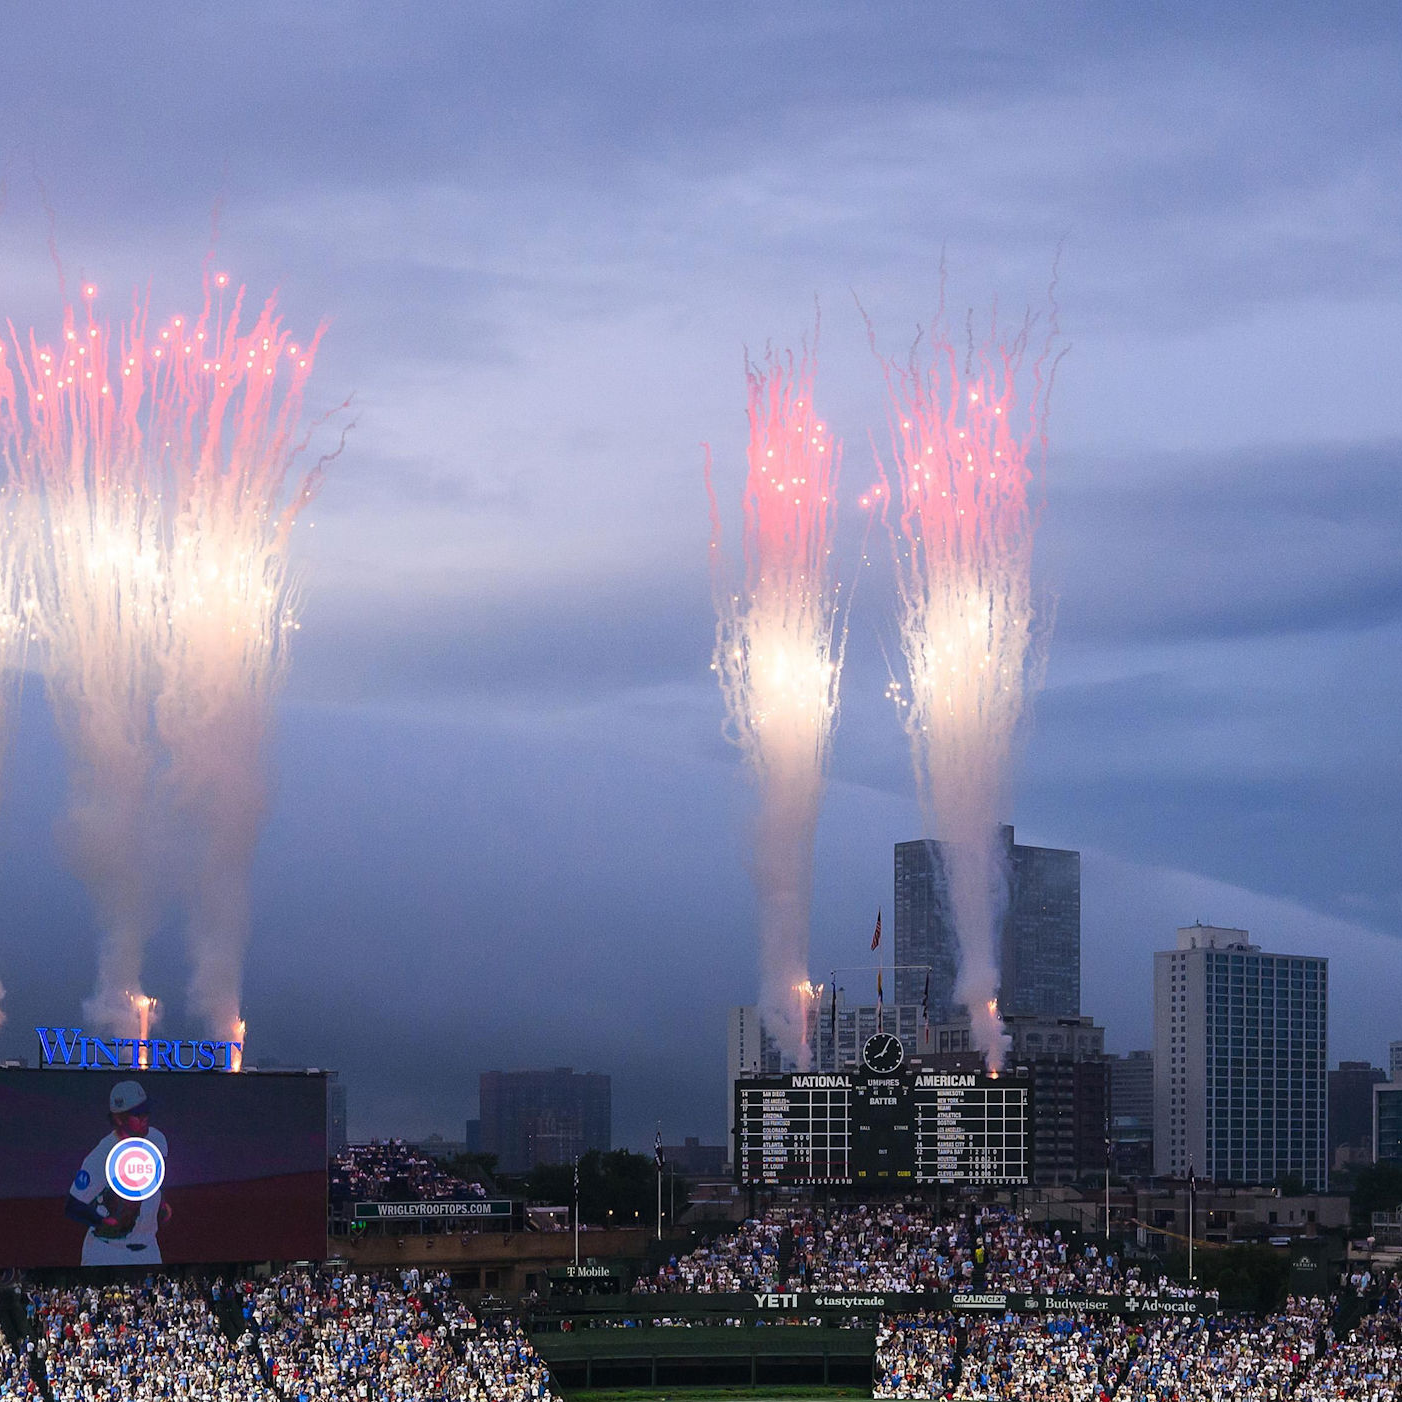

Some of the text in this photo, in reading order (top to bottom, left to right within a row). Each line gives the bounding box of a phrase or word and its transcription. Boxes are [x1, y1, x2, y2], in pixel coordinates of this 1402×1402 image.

[35, 1026, 242, 1071] WINTRUST
[792, 1076, 852, 1087] NATIONAL
[915, 1075, 975, 1087] AMERICAN
[378, 1203, 491, 1216] WRIGLEYROOFTOPS.COM
[754, 1294, 798, 1308] YETI
[824, 1294, 885, 1307] tastytrade
[953, 1294, 1007, 1304] GRAINGER
[1045, 1297, 1108, 1310] Budweiser
[1142, 1299, 1196, 1312] Advocate
